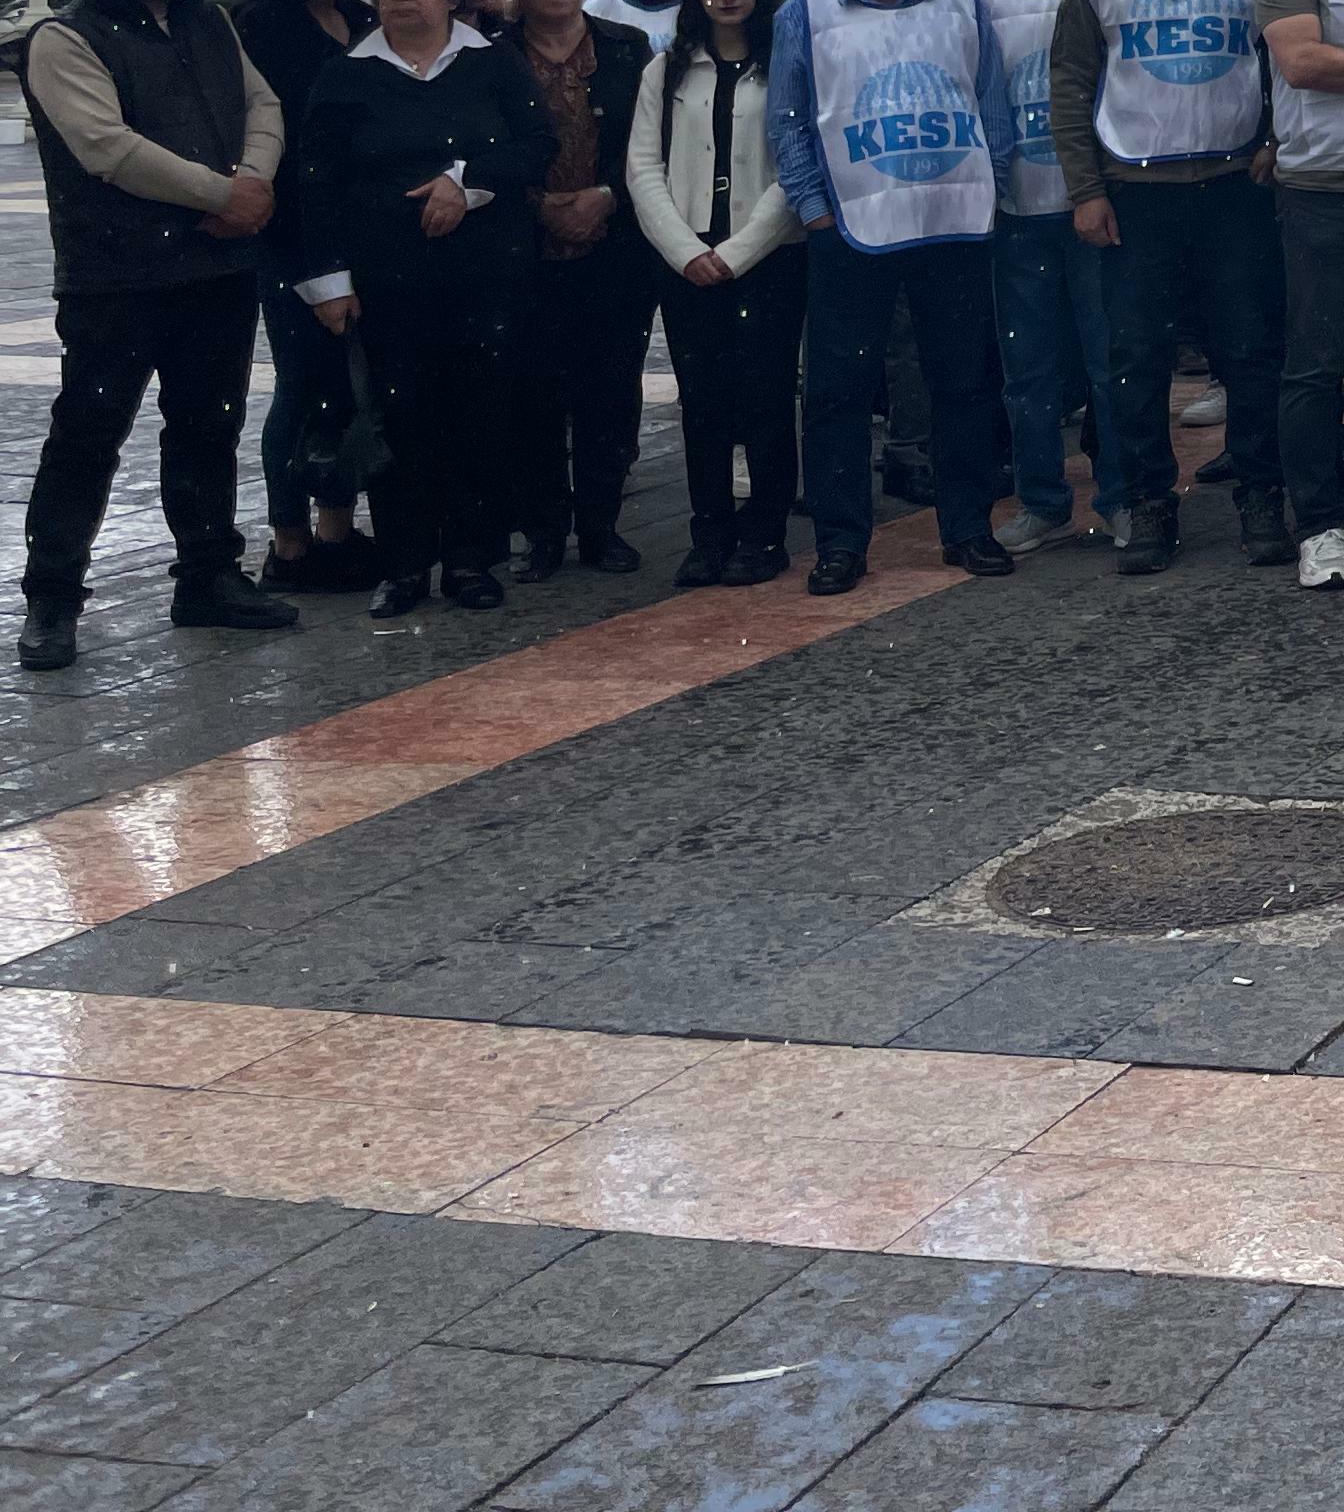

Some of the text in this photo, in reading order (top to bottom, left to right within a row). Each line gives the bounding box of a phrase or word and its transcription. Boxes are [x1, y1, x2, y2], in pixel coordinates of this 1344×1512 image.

[1119, 15, 1251, 60] KESK
[1173, 62, 1213, 80] 1995
[843, 110, 984, 163] KESK
